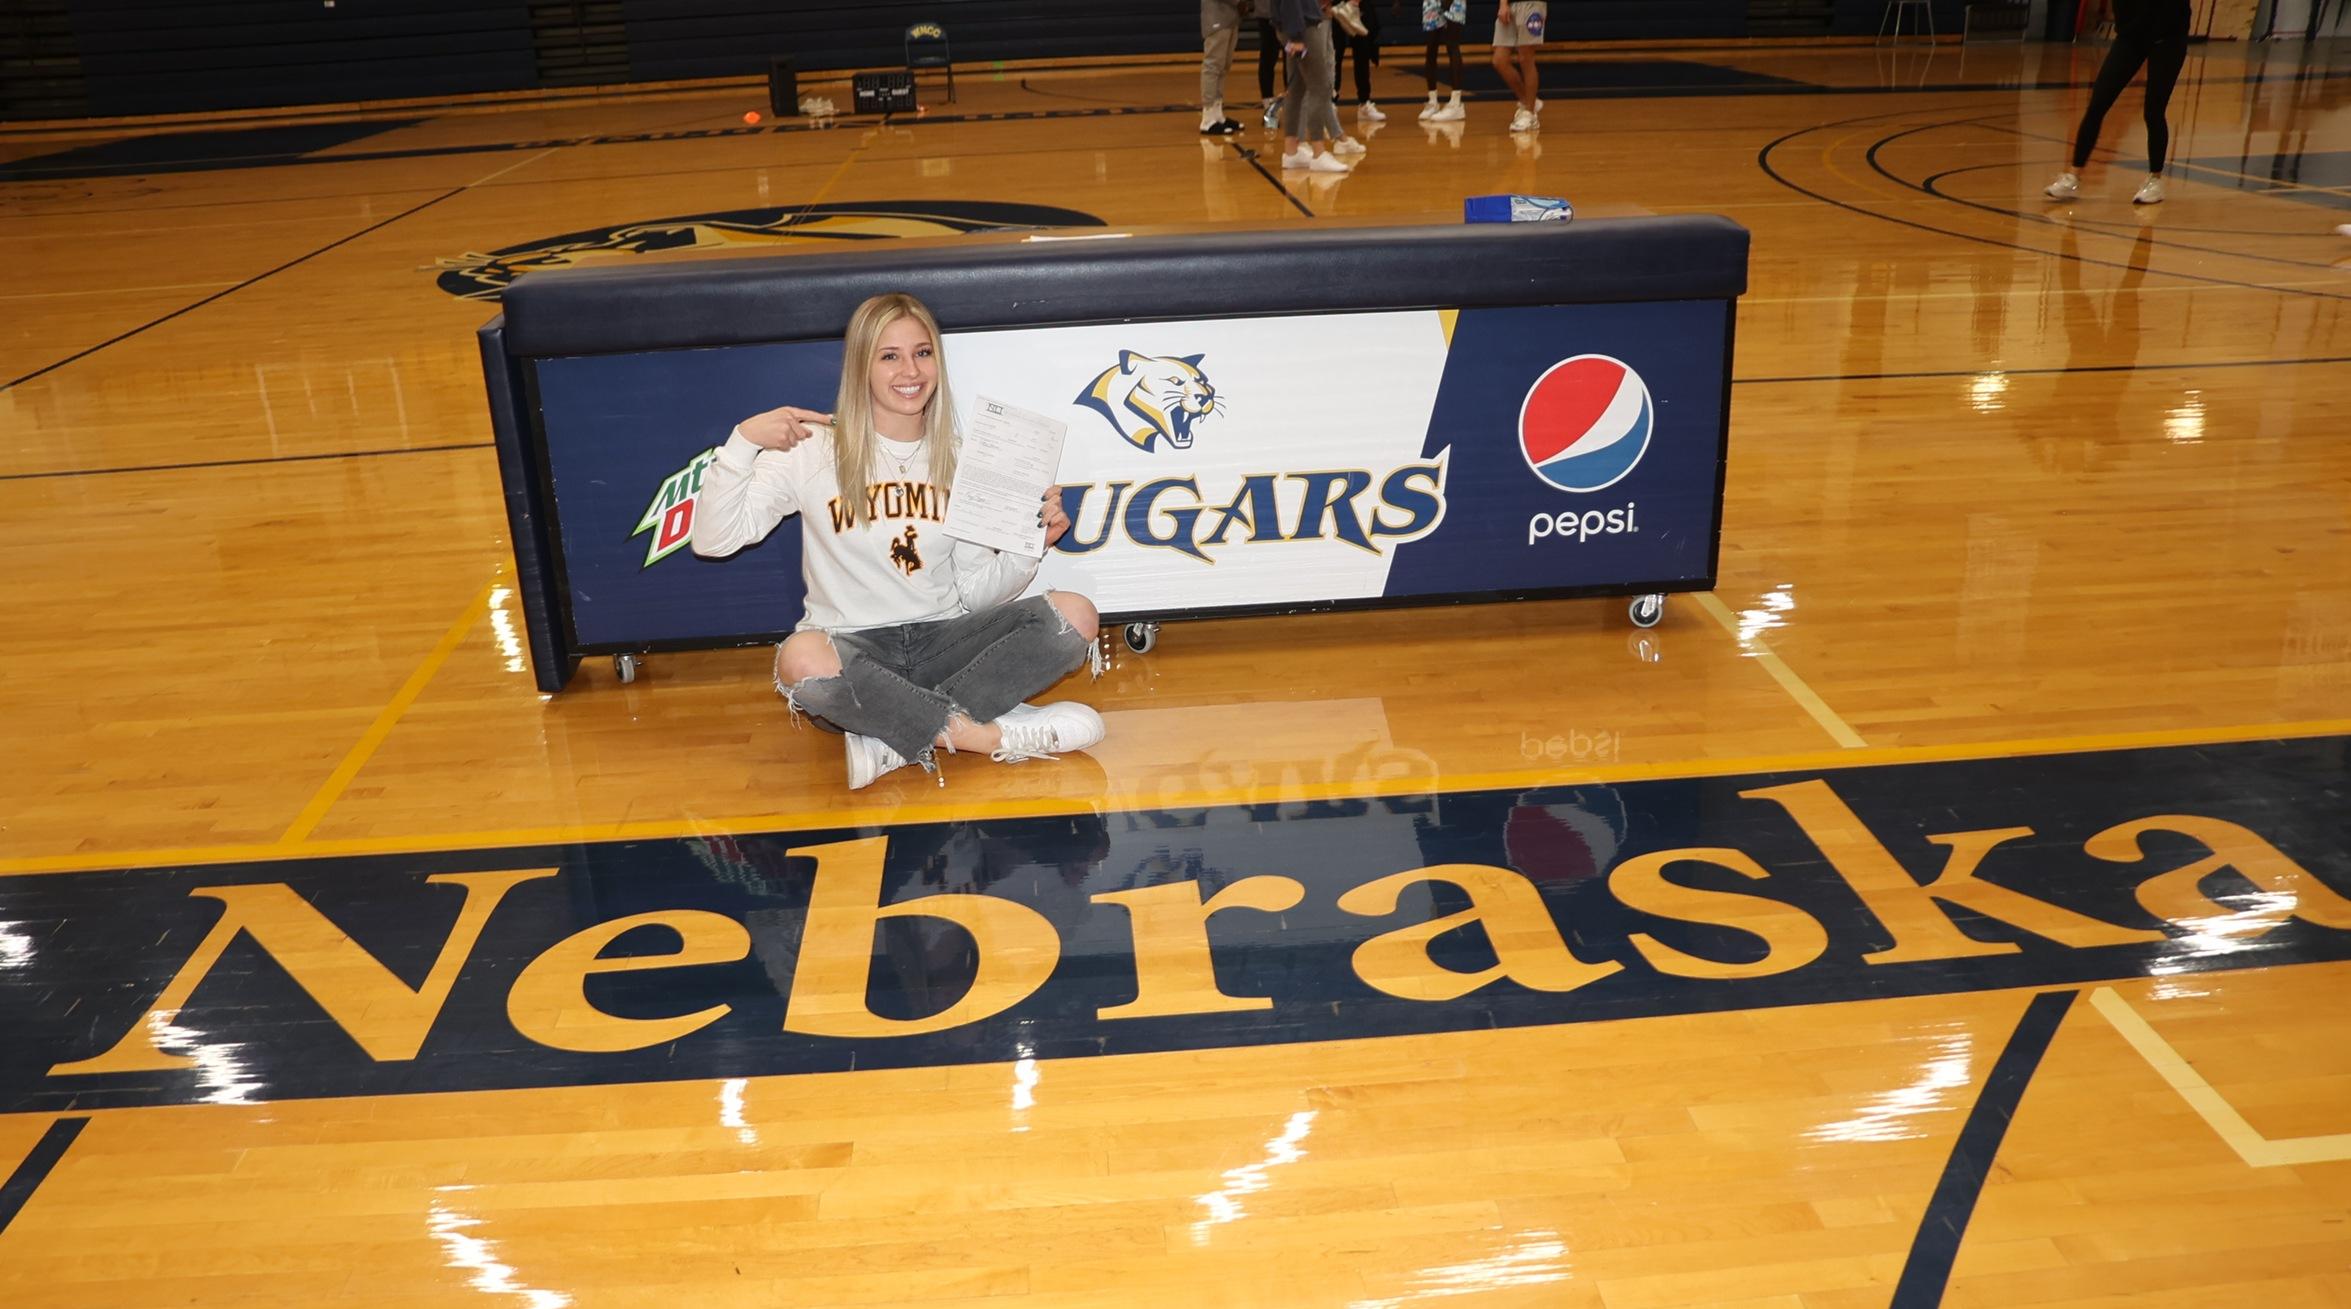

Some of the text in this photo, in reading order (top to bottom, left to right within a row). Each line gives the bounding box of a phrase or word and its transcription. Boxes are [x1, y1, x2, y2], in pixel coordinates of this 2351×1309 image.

[650, 457, 717, 518] Mt
[827, 480, 952, 535] WYOMI
[1053, 458, 1444, 566] UGARS
[1528, 502, 1635, 545] pepsi
[45, 778, 2351, 1077] Nebraska
